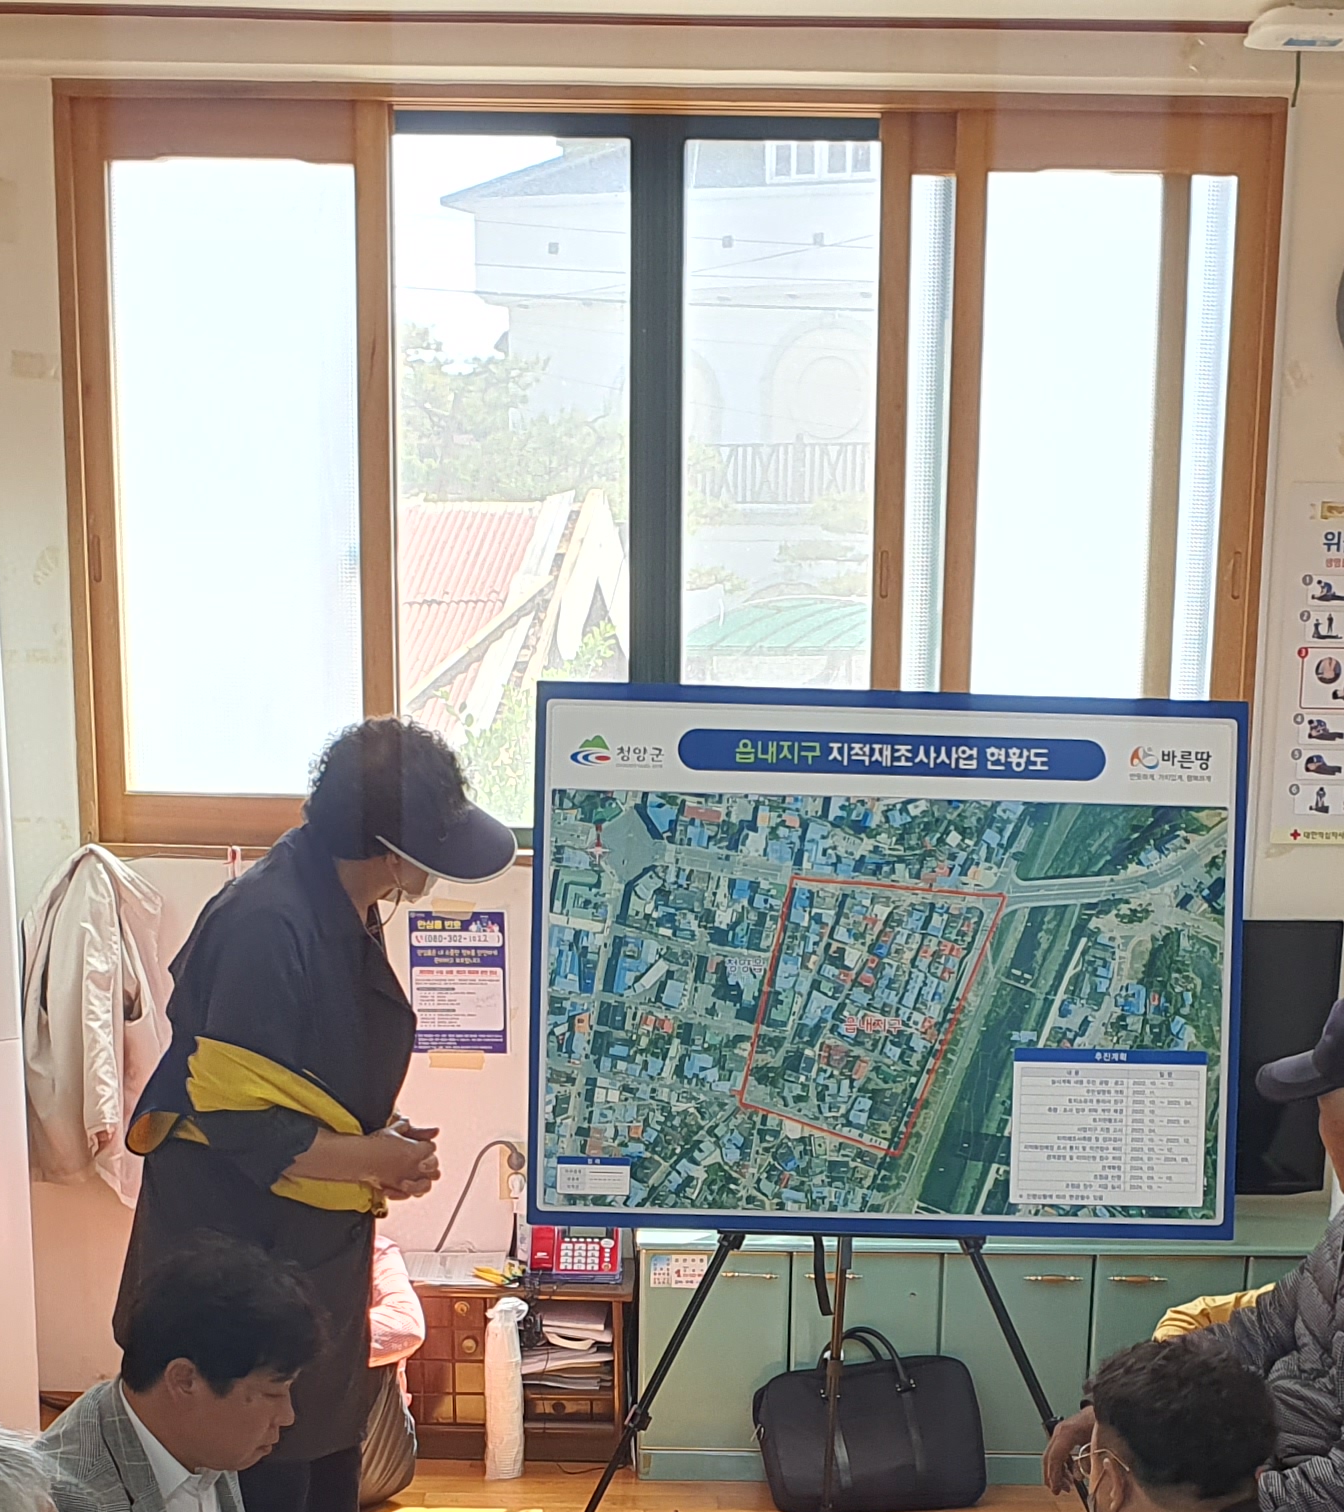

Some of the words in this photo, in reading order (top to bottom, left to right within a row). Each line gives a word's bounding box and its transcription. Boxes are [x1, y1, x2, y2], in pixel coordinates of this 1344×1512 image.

[616, 745, 665, 764] 청양군
[735, 738, 821, 765] 읍내지구
[828, 741, 979, 769] 지적재조사사업
[985, 746, 1050, 773] 현황도
[1161, 750, 1212, 771] 바른땅
[726, 958, 765, 973] 청양읍
[844, 1017, 903, 1034] 읍내지구
[1094, 1052, 1127, 1061] 추진계획
